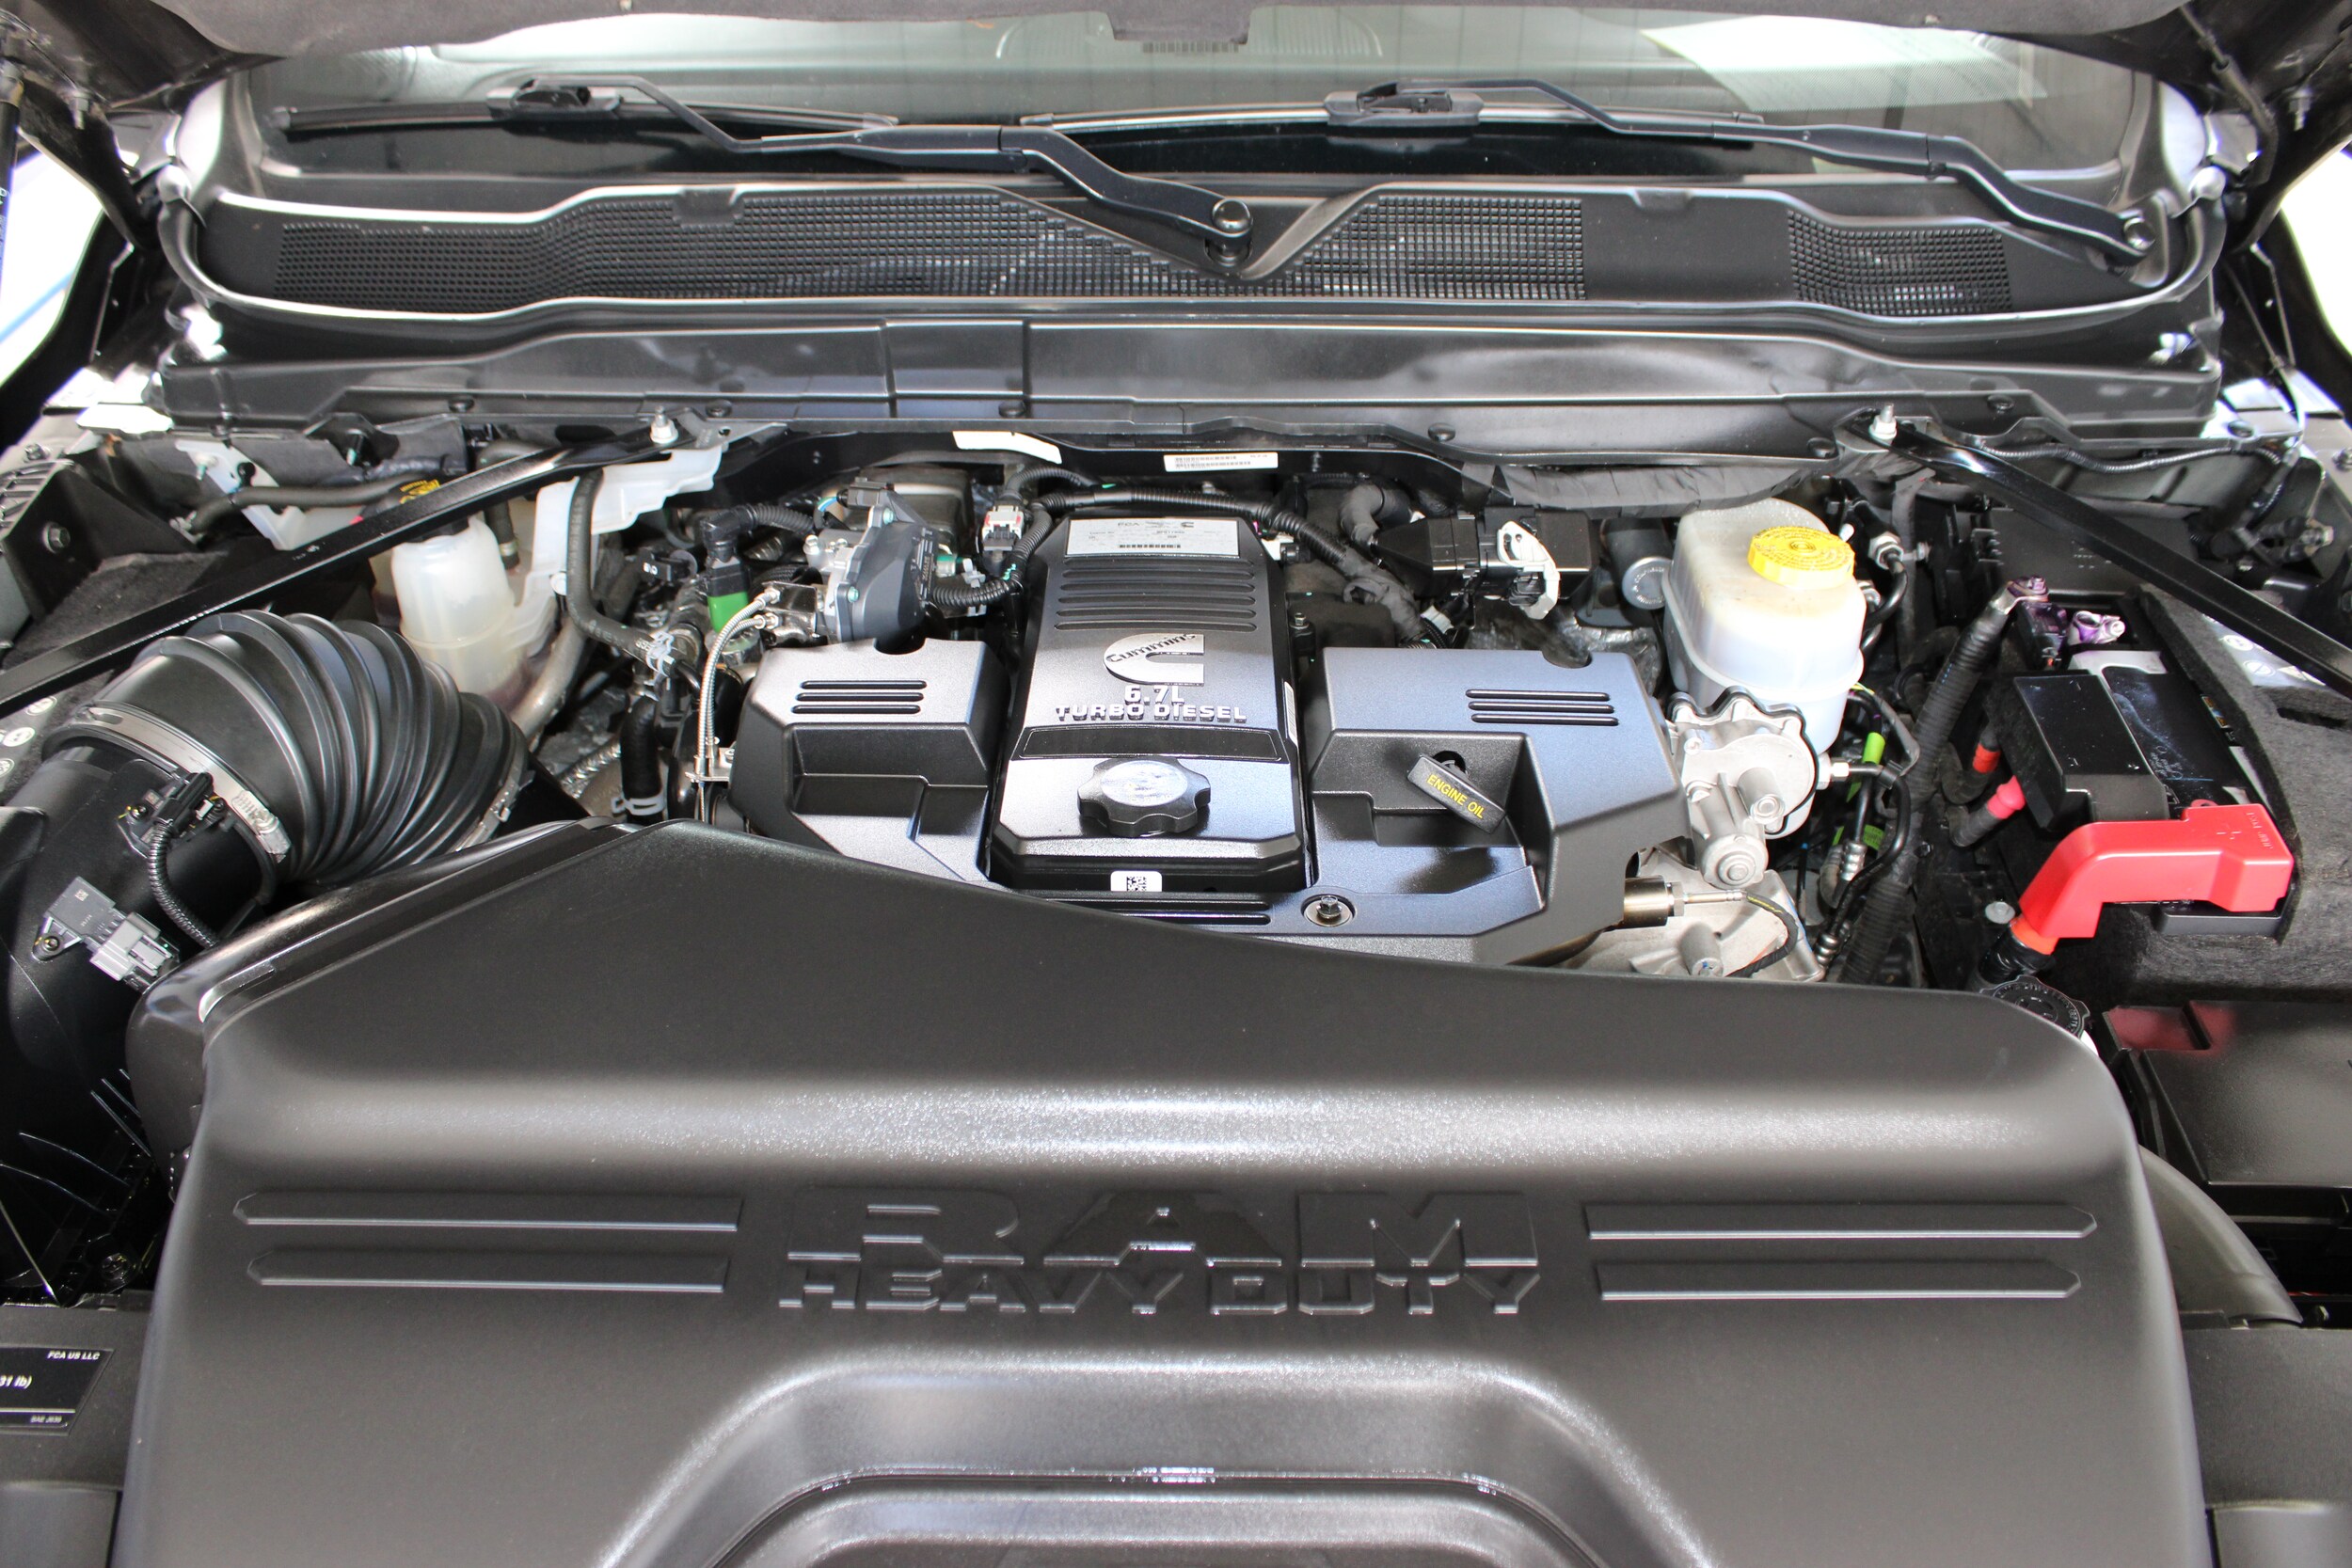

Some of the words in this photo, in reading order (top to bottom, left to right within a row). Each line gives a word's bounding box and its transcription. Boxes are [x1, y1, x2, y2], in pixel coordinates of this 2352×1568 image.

[1105, 633, 1196, 663] Cummins
[1124, 685, 1185, 705] 6.7L
[1056, 704, 1144, 721] TURBO
[1153, 704, 1248, 723] DIESEL
[1425, 772, 1468, 806] ENGINE
[1467, 800, 1486, 819] OIL
[786, 1187, 1539, 1266] RAM
[778, 1265, 1184, 1315] HEAVY
[1210, 1267, 1542, 1315] DUTY
[46, 1350, 67, 1360] FCA
[67, 1351, 81, 1360] US
[81, 1352, 101, 1361] LLC
[13, 1374, 33, 1389] lb)
